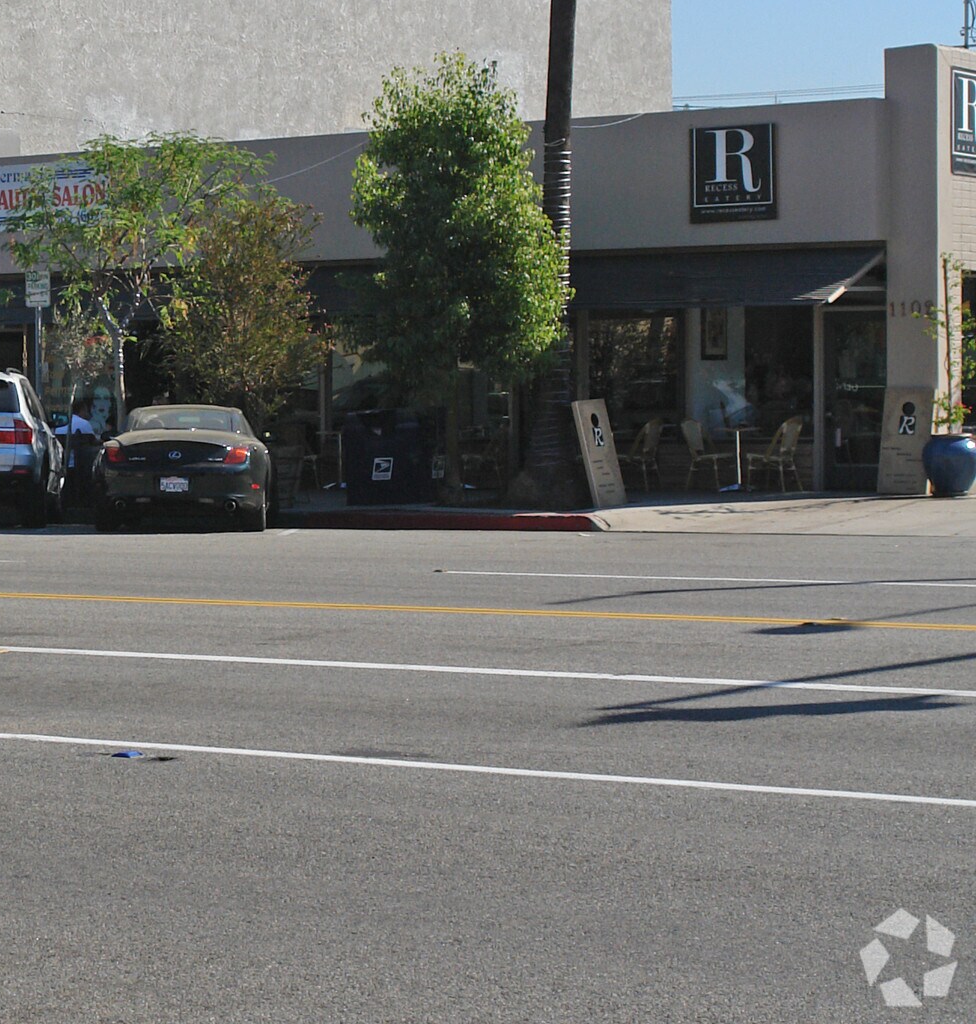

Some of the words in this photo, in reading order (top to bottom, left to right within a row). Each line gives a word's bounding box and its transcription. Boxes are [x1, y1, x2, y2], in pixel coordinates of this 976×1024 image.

[705, 128, 762, 193] R
[51, 183, 106, 208] SALON
[705, 183, 738, 193] RECESS
[704, 194, 762, 203] EATERY
